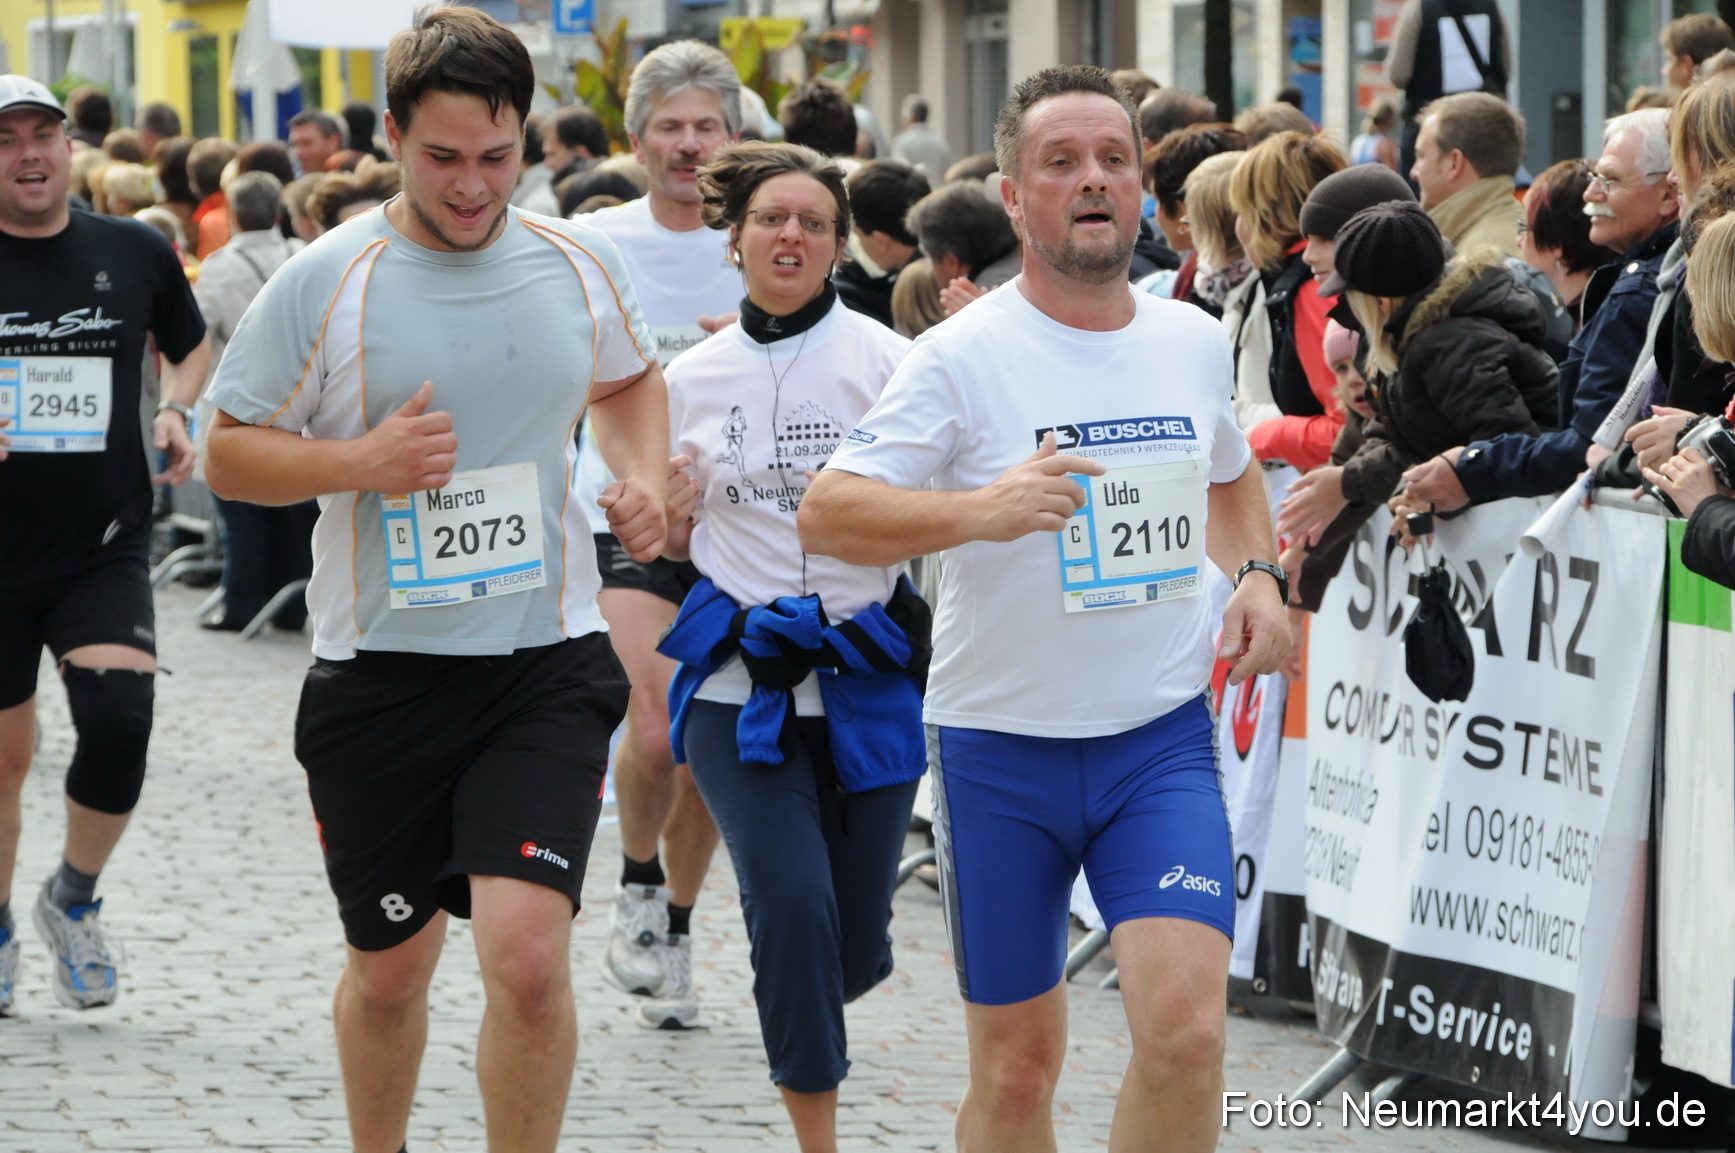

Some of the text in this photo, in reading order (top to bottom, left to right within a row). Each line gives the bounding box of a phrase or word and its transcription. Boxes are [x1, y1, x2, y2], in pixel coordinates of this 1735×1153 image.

[48, 306, 124, 338] Sabo
[68, 340, 118, 351] SILVER
[27, 365, 73, 383] Harald
[29, 393, 98, 418] 2945
[1087, 420, 1193, 442] BÜSCHEL
[776, 443, 841, 458] 21.09.200
[427, 488, 486, 512] Marco
[753, 486, 807, 502] Neuma
[1103, 480, 1140, 507] Udo
[396, 527, 407, 544] C
[433, 514, 527, 560] 2073
[1070, 525, 1081, 544] C
[1110, 514, 1191, 558] 2110
[488, 568, 543, 589] PFLEIDERER
[1159, 575, 1197, 593] PFLEIDERER
[407, 590, 449, 602] BOCK
[1083, 590, 1126, 605] BOCK
[1424, 706, 1603, 797] SYSTEME
[1420, 801, 1452, 854] el
[1182, 873, 1221, 897] asics
[380, 893, 414, 922] 8
